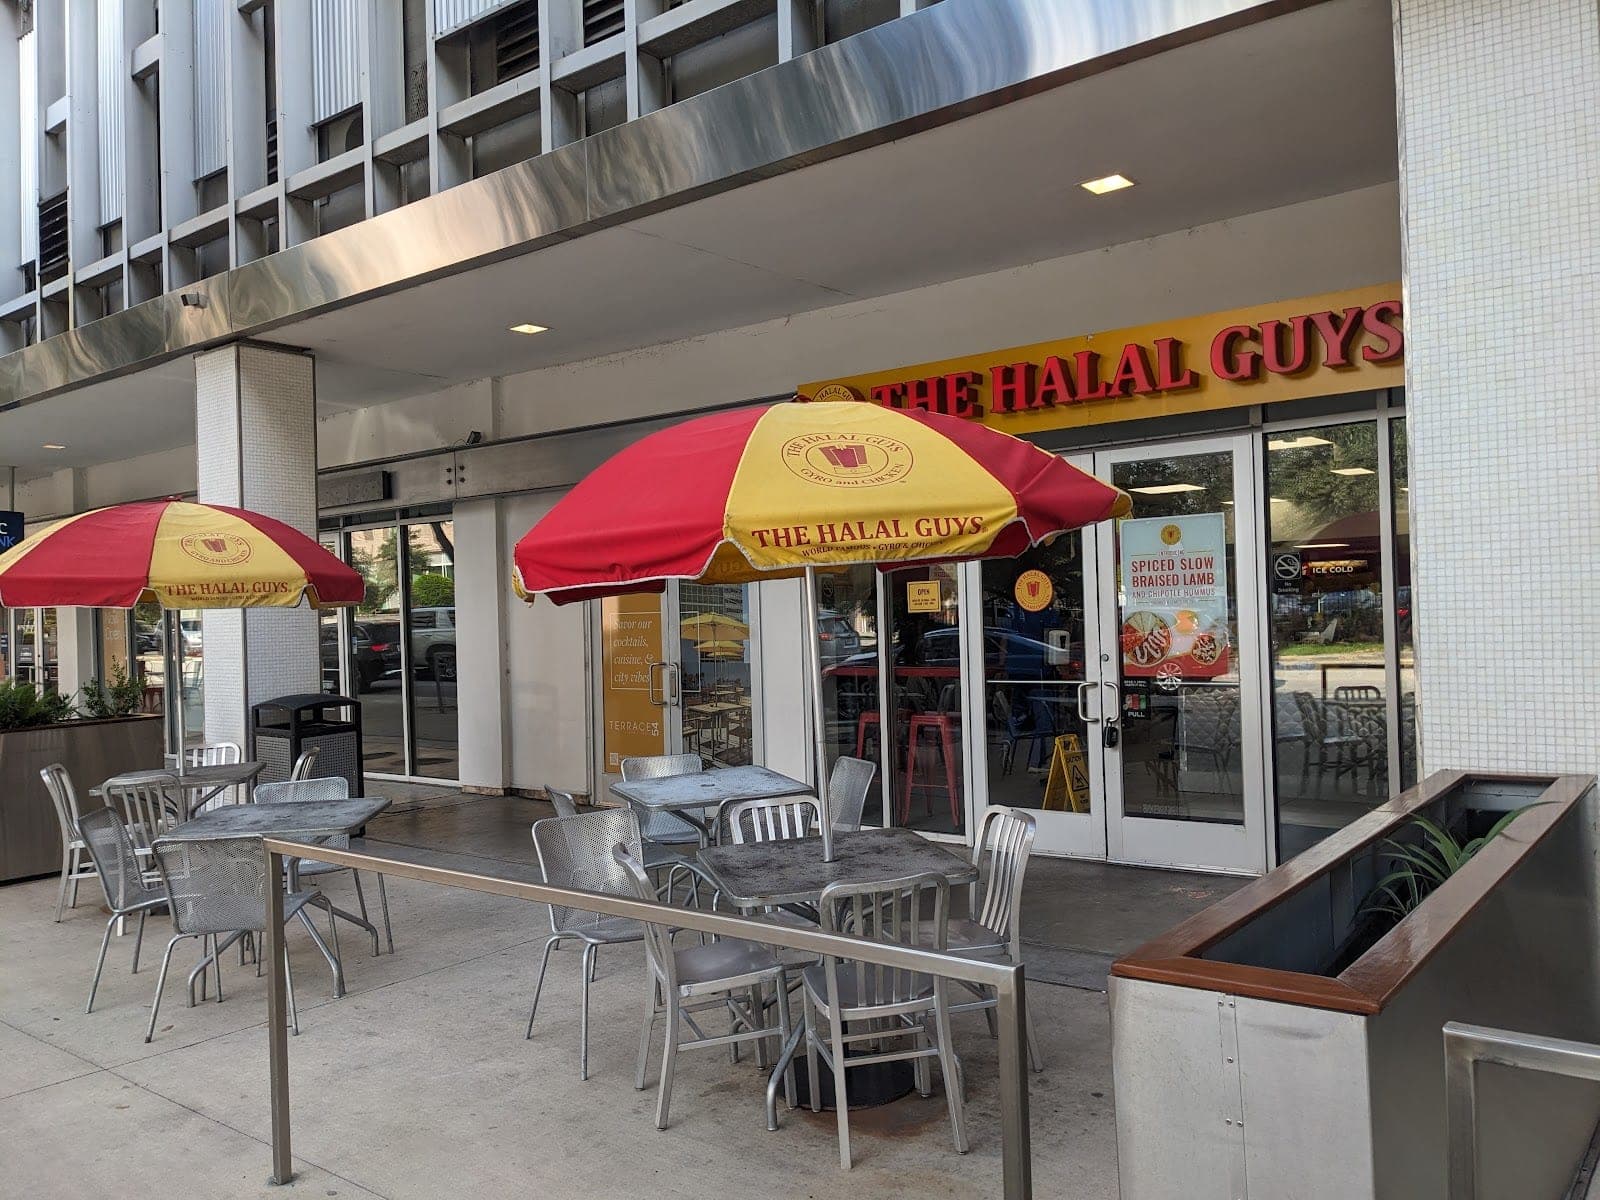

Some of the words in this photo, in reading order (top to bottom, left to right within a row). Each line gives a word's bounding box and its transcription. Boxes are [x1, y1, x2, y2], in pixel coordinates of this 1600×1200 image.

[870, 372, 976, 418] THE
[989, 337, 1194, 414] HALAL
[1210, 300, 1404, 382] GUYS
[786, 441, 804, 457] THE
[803, 434, 859, 444] HALAL
[865, 436, 904, 453] GUYS
[800, 467, 833, 484] GYRO
[751, 526, 811, 548] THE
[815, 519, 909, 544] HALAL
[915, 516, 984, 537] GUYS
[801, 545, 833, 558] WORLD
[878, 542, 901, 551] GYRO
[1131, 558, 1175, 573] SPICED
[1180, 556, 1214, 571] SLOW
[1312, 566, 1327, 574] ICE
[1329, 565, 1354, 574] COLD
[1132, 574, 1179, 588] BRAISED
[1183, 572, 1215, 586] LAMB
[165, 584, 197, 596] THE
[199, 582, 249, 594] HALAL
[252, 581, 289, 593] GUYS
[1132, 591, 1146, 599] AND
[1148, 588, 1181, 598] CHIPOTLE
[1183, 586, 1216, 597] HUMMUS
[637, 620, 652, 629] our
[609, 720, 651, 731] TERRACE
